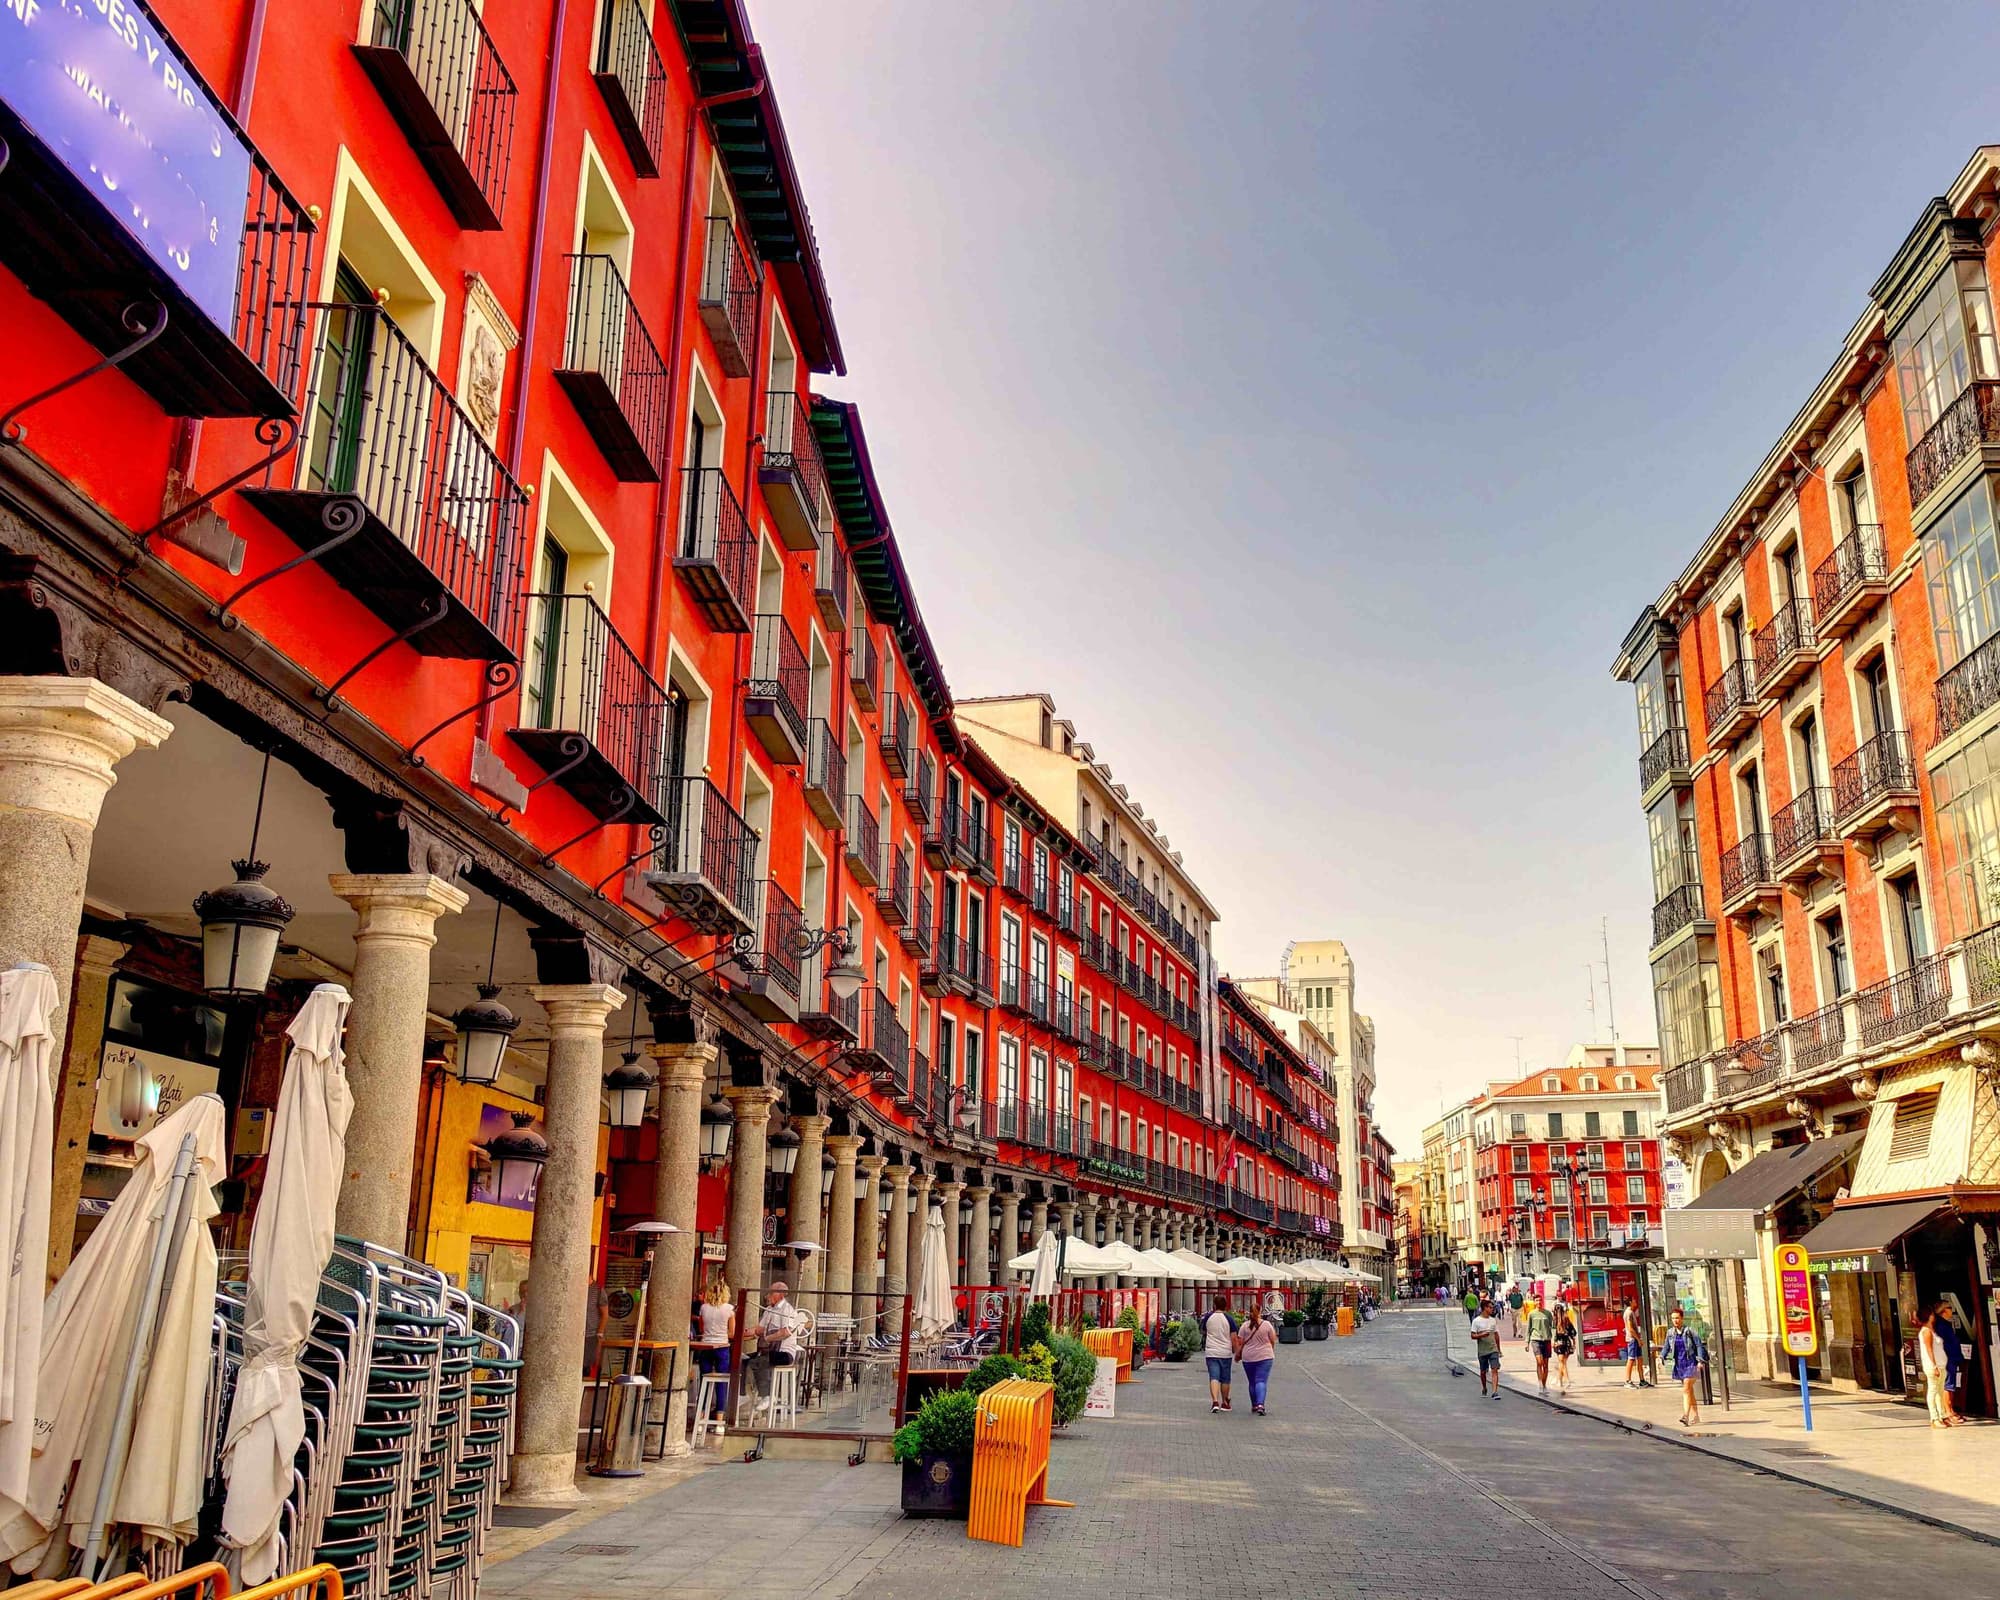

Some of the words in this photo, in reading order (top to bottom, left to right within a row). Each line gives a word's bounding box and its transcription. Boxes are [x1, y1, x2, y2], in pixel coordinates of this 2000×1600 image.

[143, 35, 160, 66] Y
[1788, 1253, 1796, 1264] 8
[1784, 1274, 1798, 1283] bus
